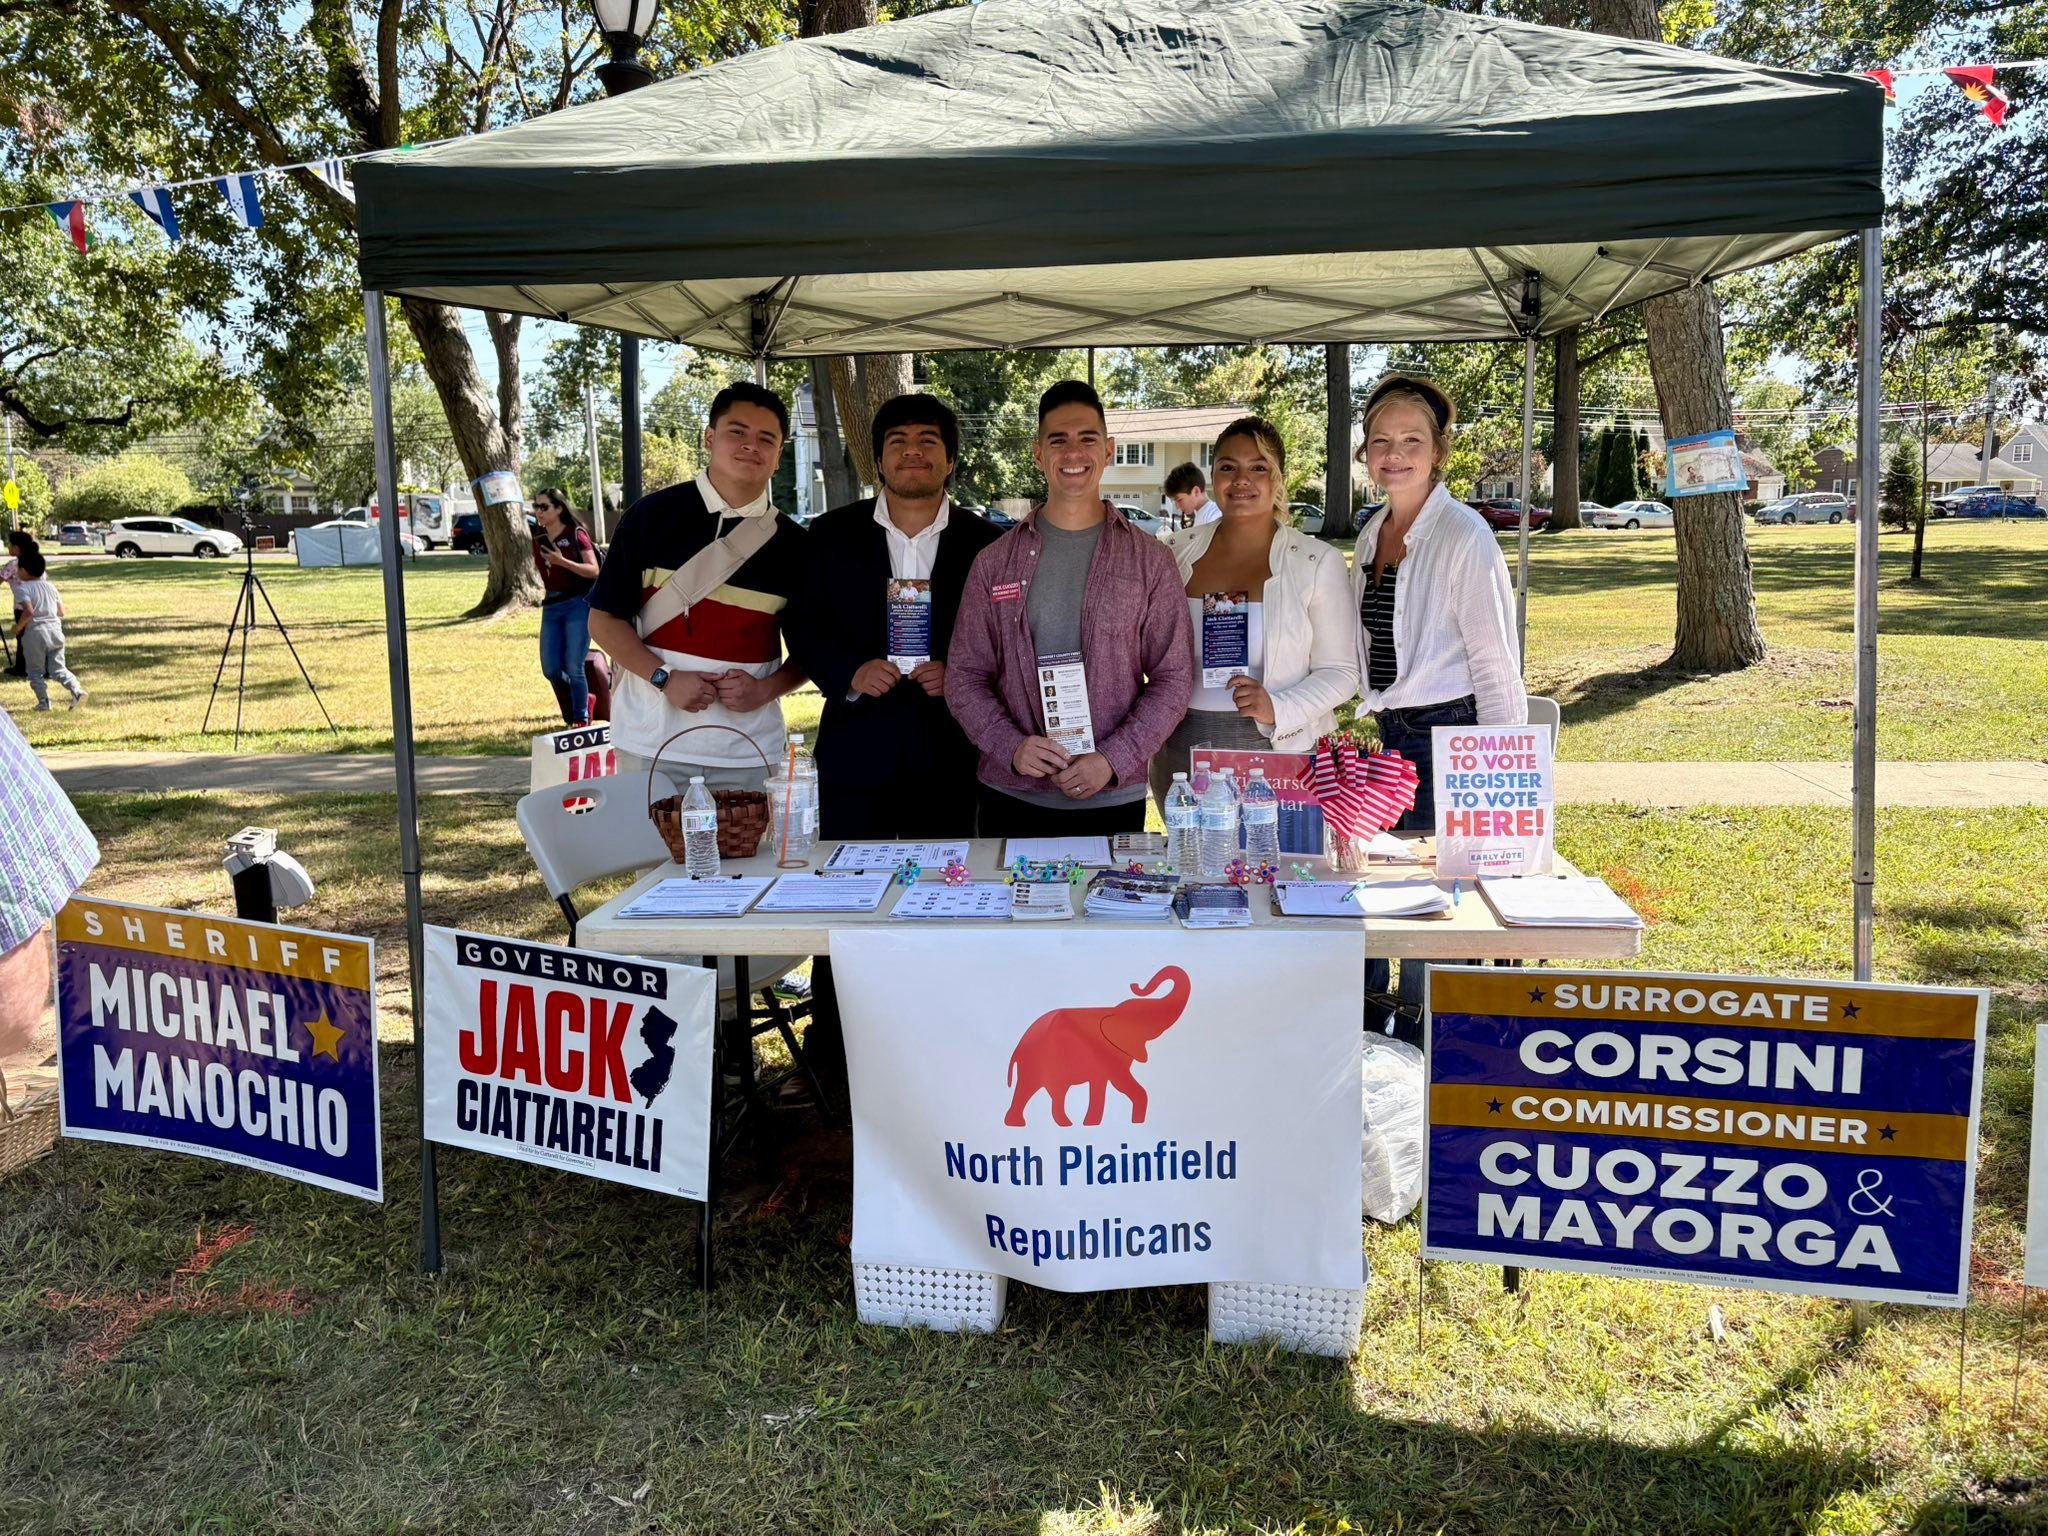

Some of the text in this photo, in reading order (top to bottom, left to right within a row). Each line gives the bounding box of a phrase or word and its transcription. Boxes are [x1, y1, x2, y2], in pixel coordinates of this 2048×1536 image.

[1450, 735, 1536, 752] COMMIT
[1450, 754, 1537, 770] TO VOTE
[1446, 773, 1542, 789] REGISTER
[1451, 791, 1538, 808] TO VOTE
[1446, 809, 1545, 837] HERE!
[1471, 853, 1498, 861] EARLY
[83, 911, 341, 973] SHERIFF
[465, 943, 658, 993] GOVERNOR
[90, 963, 299, 1063] MICHAEL
[1553, 983, 1829, 1022] SURROGATE
[459, 979, 633, 1104] JACK
[1519, 1029, 1864, 1095] CORSINI
[94, 1044, 348, 1158] MANOCHIO
[457, 1078, 664, 1173] CIATTARELLI
[1511, 1096, 1867, 1145] COMMISSIONER
[540, 1151, 559, 1159] Ciattarelli
[944, 1140, 1237, 1187] North Plainfield
[1479, 1141, 1896, 1217] CUOZZO &
[985, 1214, 1212, 1267] Republicans
[1478, 1195, 1901, 1274] MAYORGA
